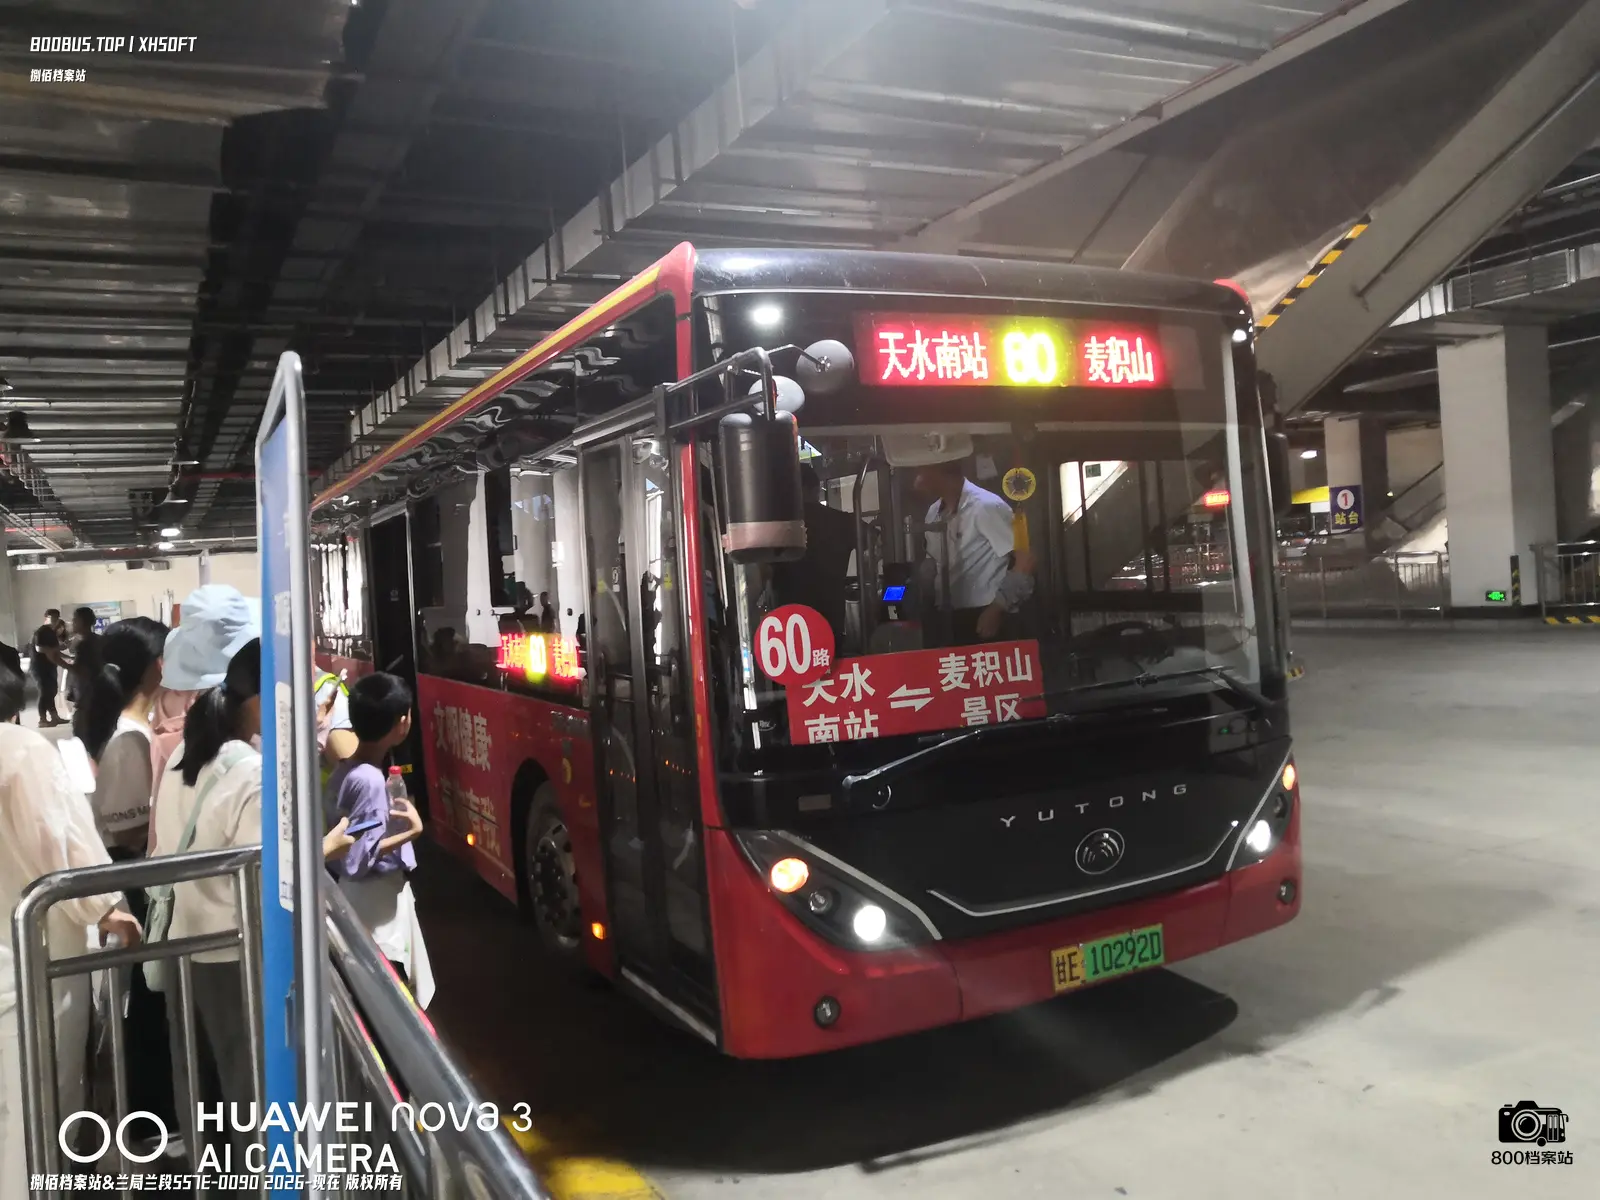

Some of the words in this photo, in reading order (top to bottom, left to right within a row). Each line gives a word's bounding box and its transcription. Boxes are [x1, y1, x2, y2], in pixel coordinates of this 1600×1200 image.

[878, 330, 989, 381] 天水南站
[1003, 332, 1056, 383] 60
[1083, 336, 1155, 383] 麦积山
[1334, 511, 1359, 525] 站台
[938, 647, 1034, 693] 麦积山
[960, 693, 1023, 727] 景区
[1000, 784, 1188, 828] YUTONG
